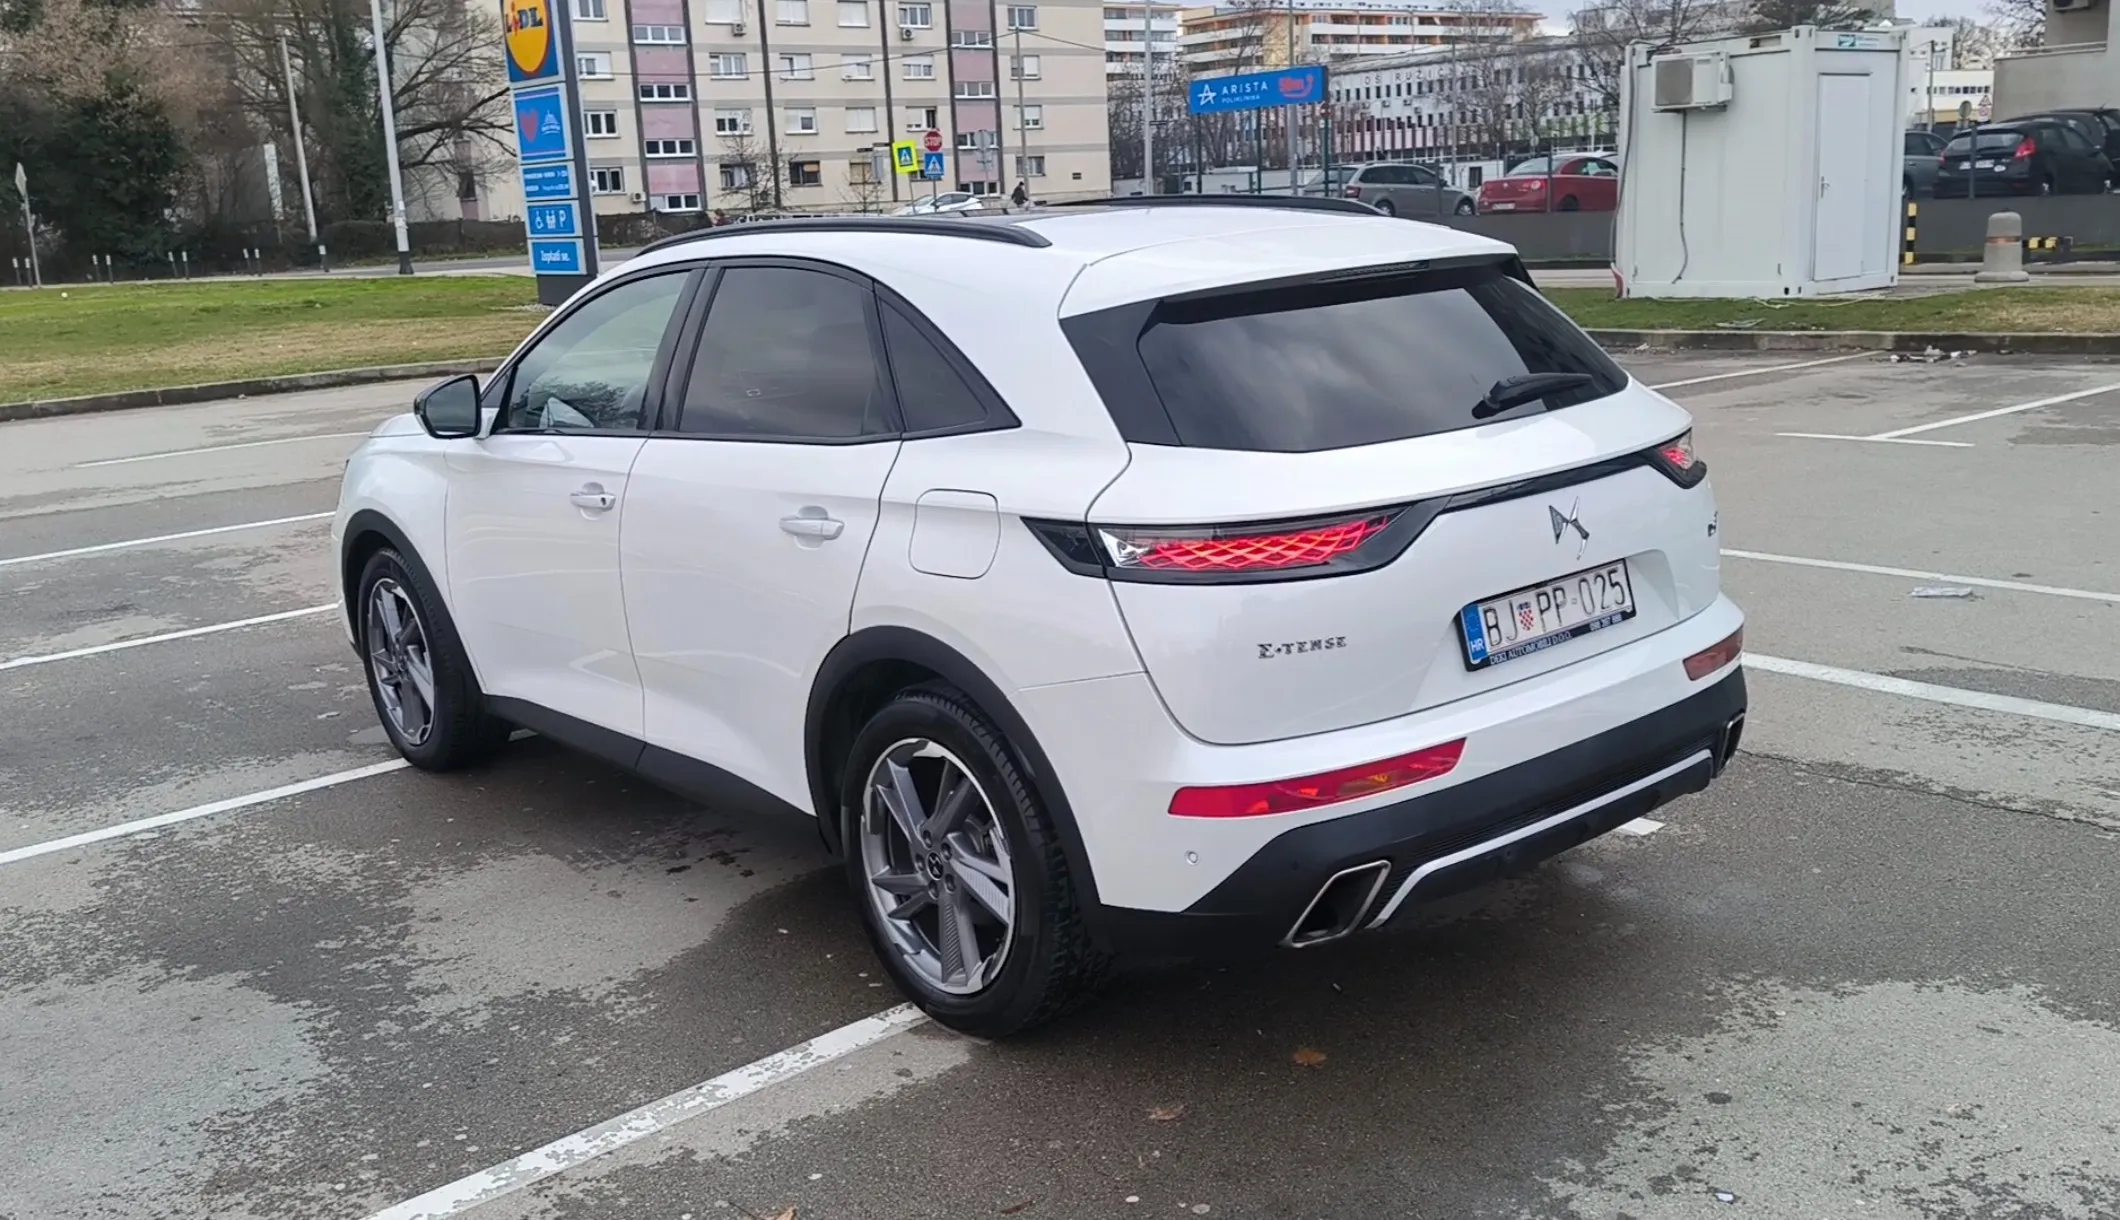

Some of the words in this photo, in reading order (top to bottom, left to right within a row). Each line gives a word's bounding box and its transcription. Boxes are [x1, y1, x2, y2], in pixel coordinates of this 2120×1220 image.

[1221, 81, 1269, 96] ARISTA
[1221, 94, 1261, 104] POLIKLINIKA
[924, 136, 942, 147] STOP
[1483, 600, 1519, 648] BJ
[1535, 567, 1627, 633] PP-025
[1470, 638, 1485, 651] HR
